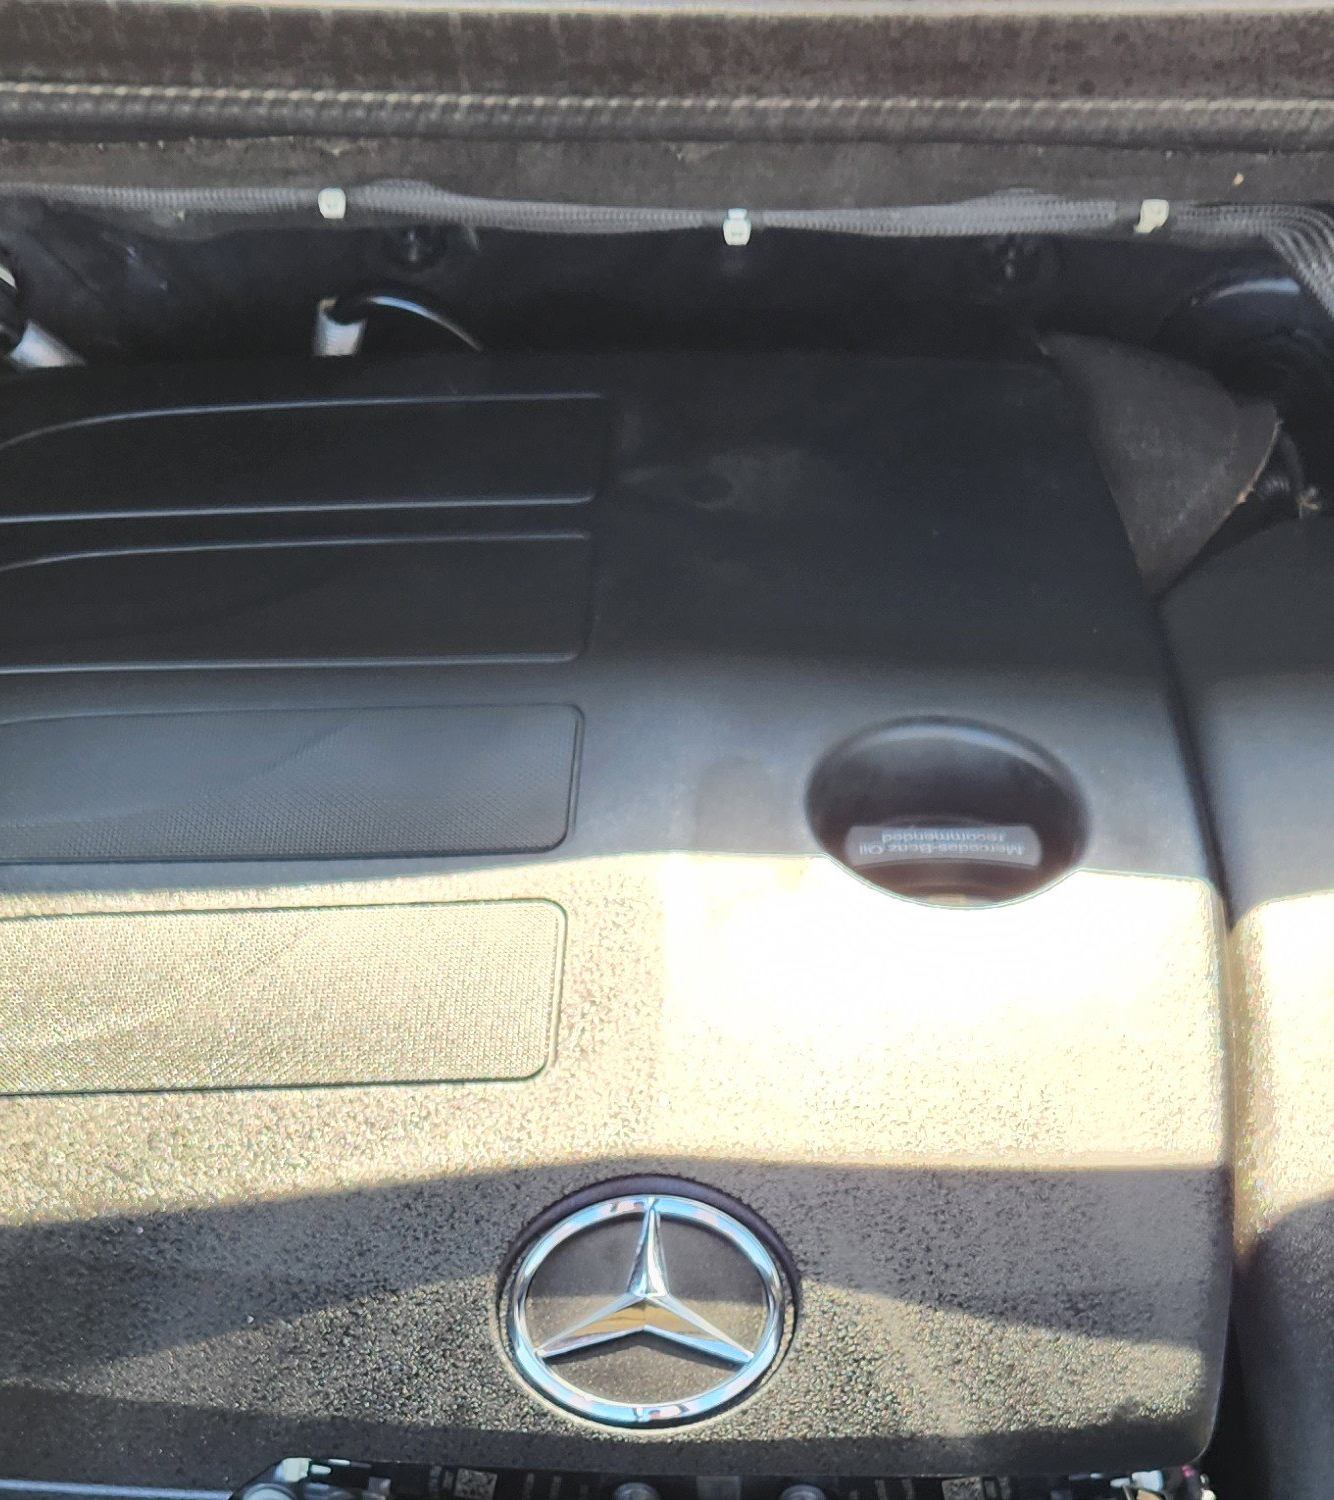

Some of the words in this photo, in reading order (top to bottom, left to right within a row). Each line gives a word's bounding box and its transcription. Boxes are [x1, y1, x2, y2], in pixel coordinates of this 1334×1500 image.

[882, 832, 1004, 843] recommended
[859, 843, 883, 855] Oil
[888, 843, 1023, 855] Mercedes-Benz
